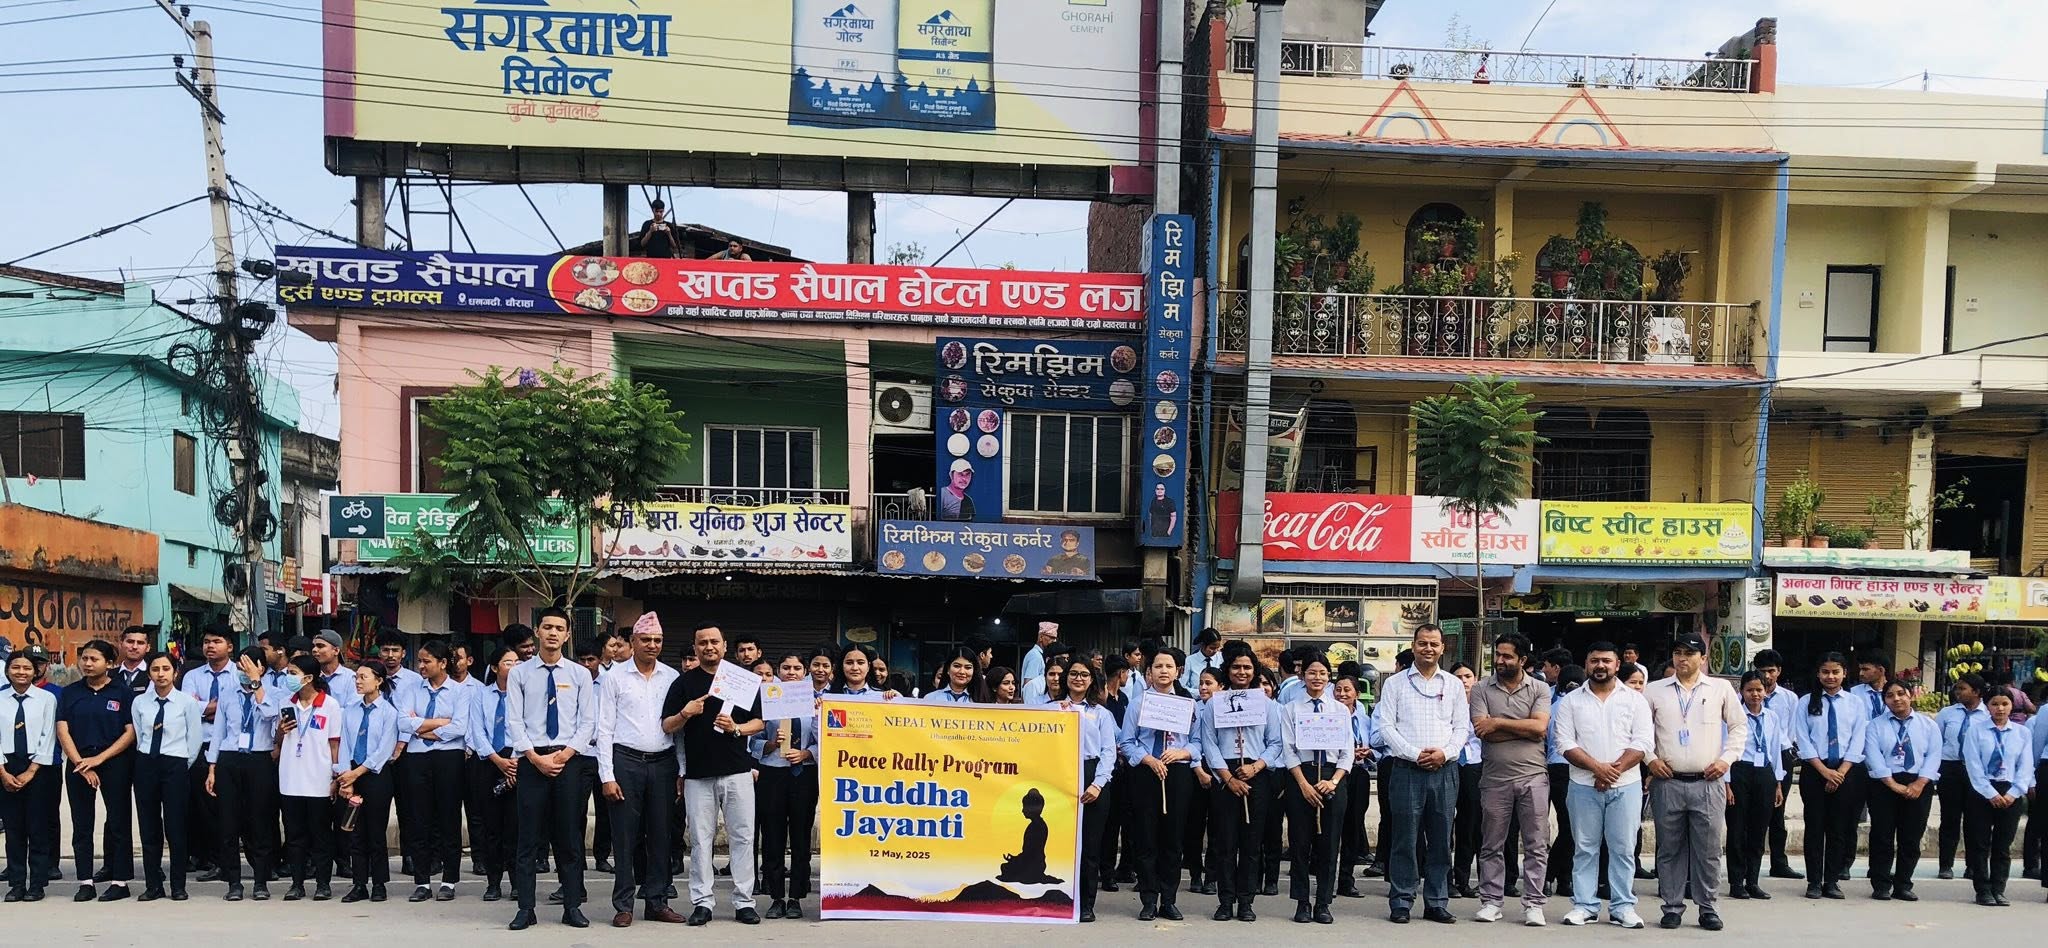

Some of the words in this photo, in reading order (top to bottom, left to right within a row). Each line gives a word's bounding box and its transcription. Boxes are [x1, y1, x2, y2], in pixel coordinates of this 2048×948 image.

[441, 7, 672, 57] सगरमाथा
[823, 17, 874, 30] सगरमाथा
[836, 29, 863, 42] गोल्ड
[917, 24, 972, 37] सगरमाथा
[1070, 24, 1105, 34] CEMENT
[501, 56, 612, 98] सिमेन्ट
[416, 253, 539, 289] सैपाल
[321, 287, 364, 302] एण्ड
[371, 288, 444, 307] ट्राभल्स
[678, 270, 780, 301] खप्तड
[790, 263, 889, 305] सैपाल
[899, 269, 990, 308] होटल
[1000, 281, 1070, 310] एण्ड
[1080, 283, 1144, 313] लज
[973, 342, 1106, 377] रिमझिम
[980, 377, 1035, 405] सेकुवा
[753, 512, 787, 538] शुज
[793, 507, 846, 534] सेन्टर
[1602, 511, 1655, 536] स्वीट
[1662, 517, 1724, 537] हाउस
[959, 526, 1007, 553] सेकुवा
[1013, 528, 1053, 548] कर्नर
[1421, 528, 1469, 550] स्वीट
[1782, 578, 1826, 590] अनन्या
[1830, 576, 1863, 591] गिफ्ट
[1867, 580, 1900, 594] हाउस
[1903, 581, 1929, 594] एण्ड
[1949, 580, 1985, 596] सेन्टर
[884, 716, 927, 728] NEPAL
[930, 718, 996, 731] WESTERN
[999, 721, 1067, 734] ACADEMY
[978, 735, 1006, 743] Santoshi
[1008, 736, 1020, 744] Tole
[837, 749, 887, 770] Peace
[892, 752, 939, 777] Rally
[942, 755, 1019, 780] Program
[833, 777, 970, 809] Buddha
[835, 809, 964, 842] Jayanti
[869, 849, 880, 858] 12
[882, 850, 904, 860] May,
[906, 851, 931, 860] 2025
